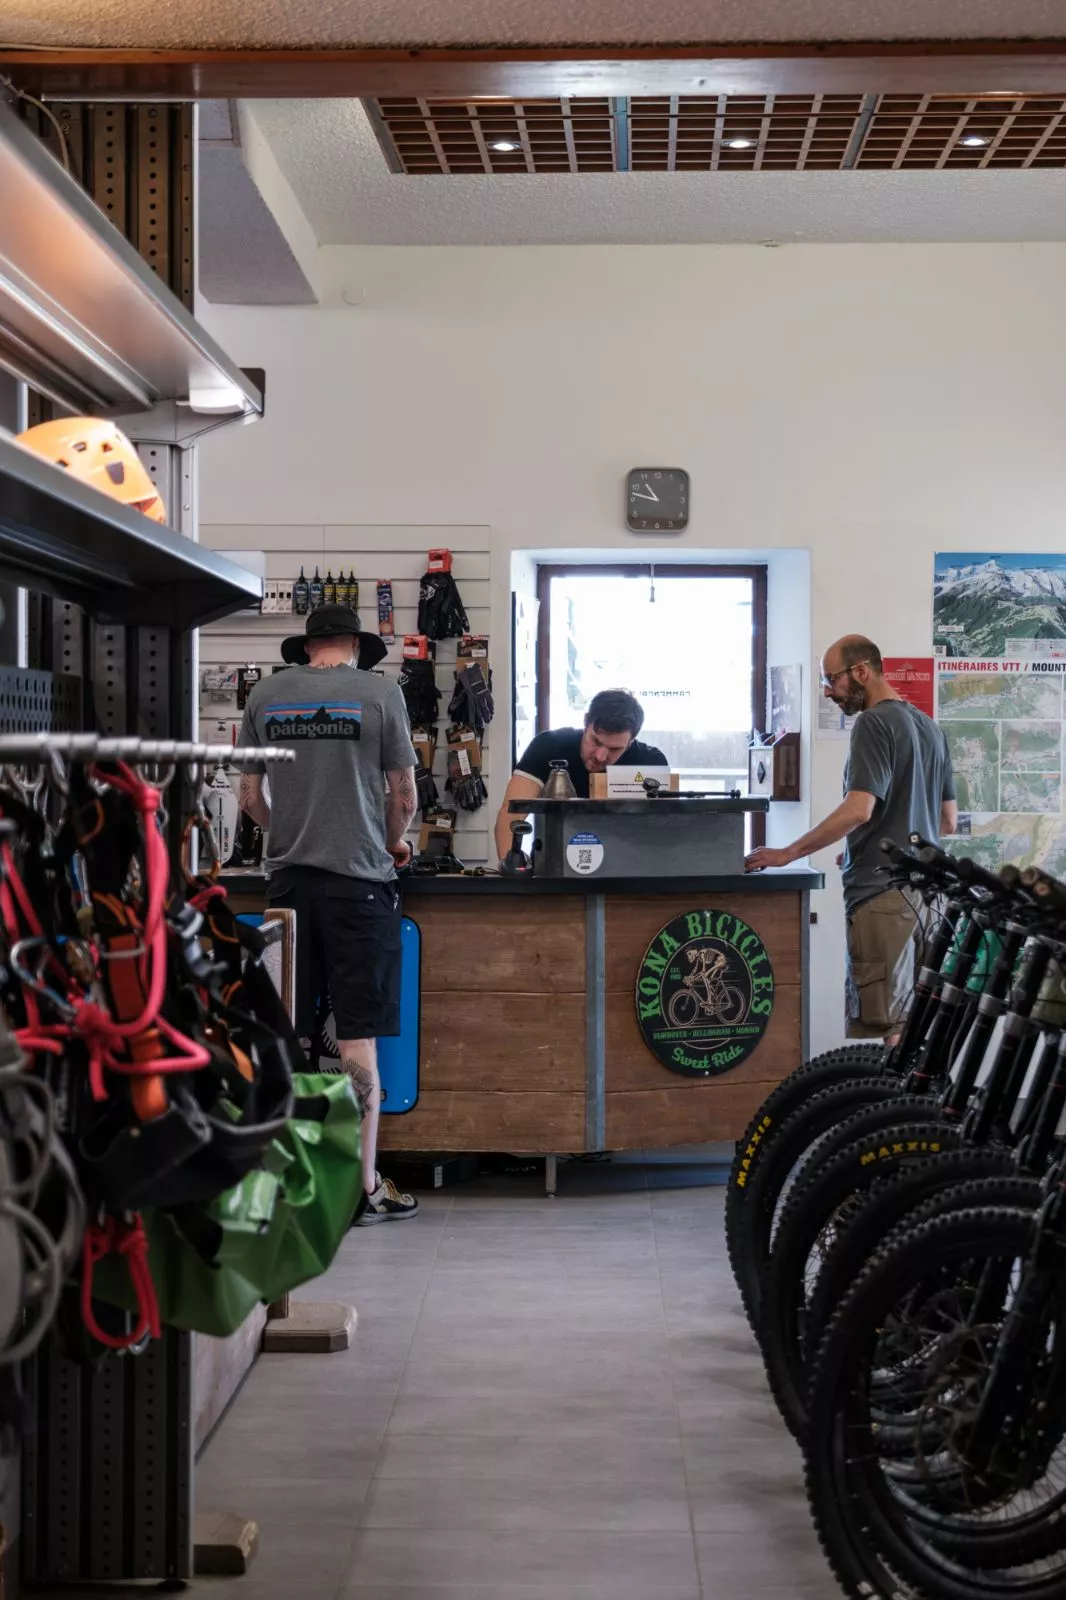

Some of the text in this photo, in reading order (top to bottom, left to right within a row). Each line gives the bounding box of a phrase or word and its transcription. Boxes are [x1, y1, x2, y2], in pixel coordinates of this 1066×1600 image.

[641, 473, 648, 481] 11
[938, 660, 999, 672] ITINÉRAIRES
[1002, 662, 1021, 672] VTT
[269, 720, 354, 739] patagonia
[639, 911, 773, 1020] KONA BICYCLES
[671, 1044, 745, 1069] Sweet Ride
[736, 1115, 771, 1188] MAXXIS
[860, 1141, 940, 1166] MAXXIS
